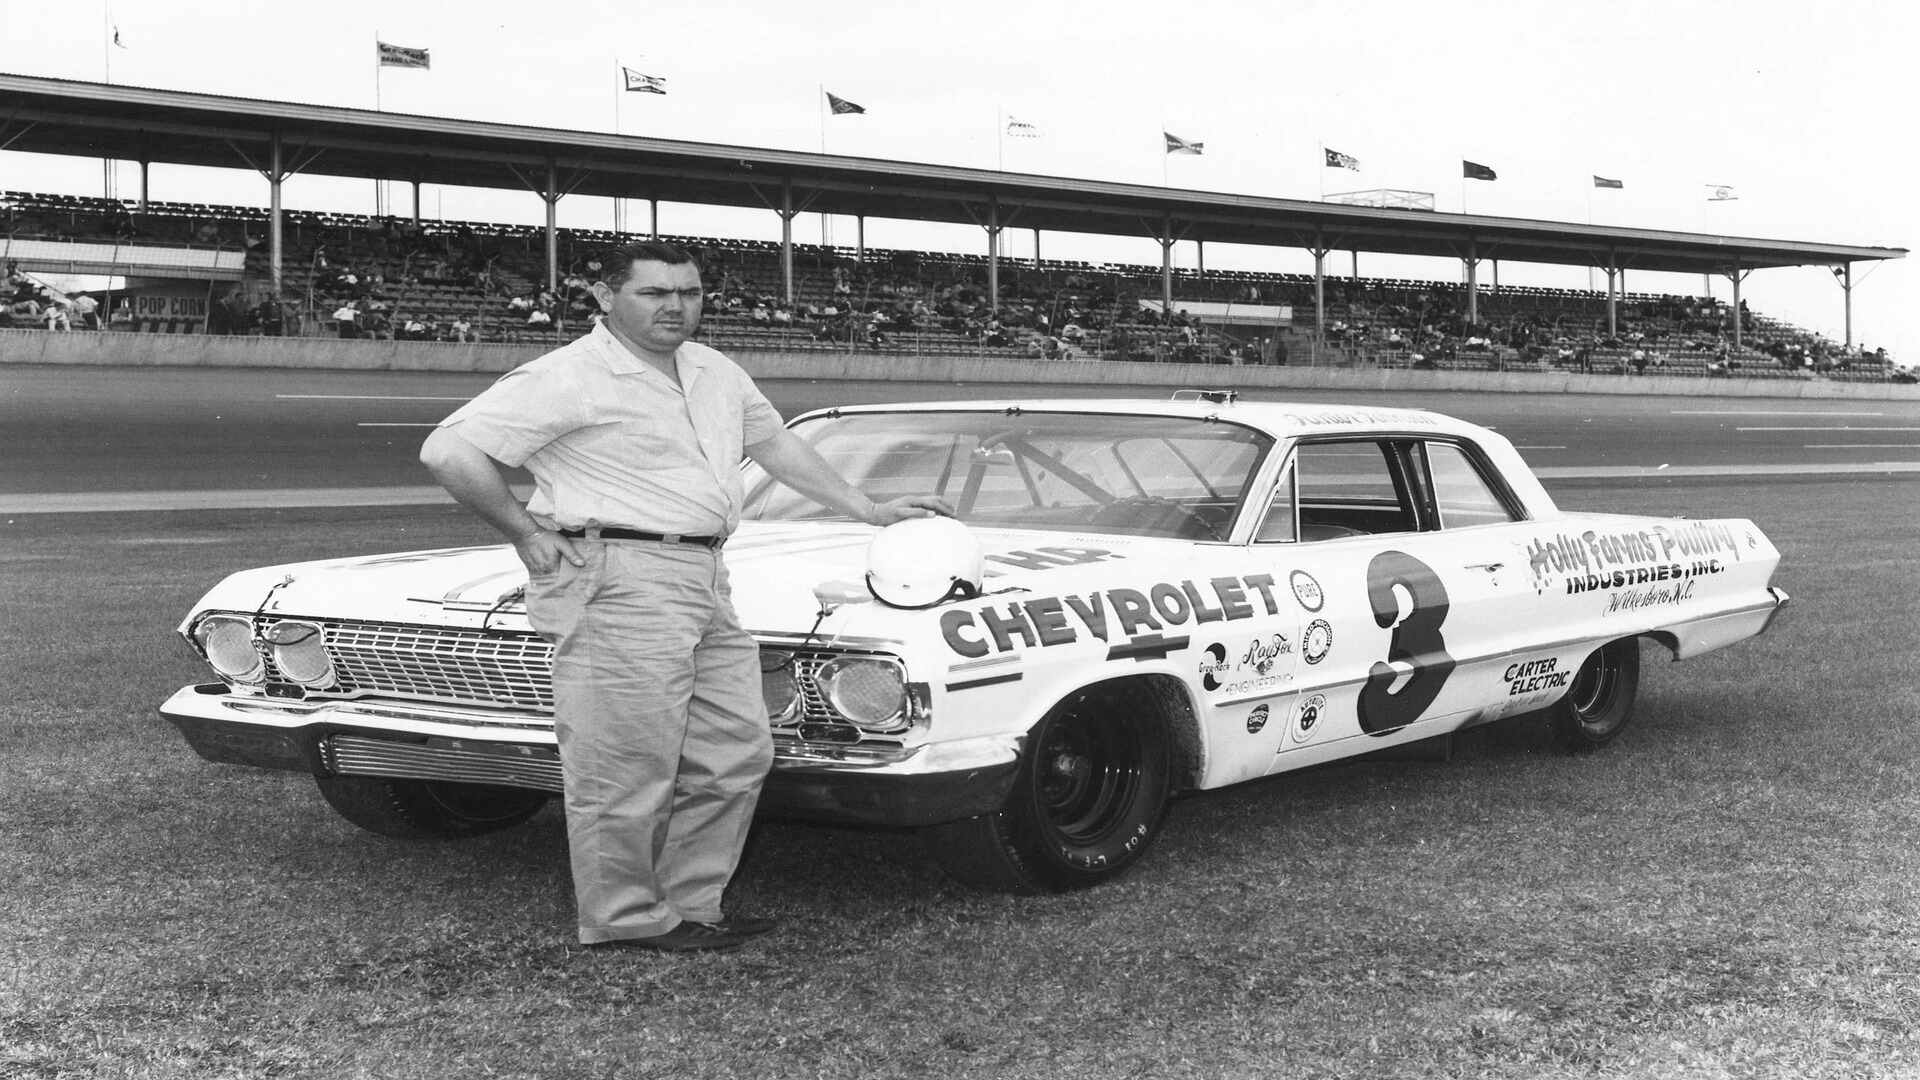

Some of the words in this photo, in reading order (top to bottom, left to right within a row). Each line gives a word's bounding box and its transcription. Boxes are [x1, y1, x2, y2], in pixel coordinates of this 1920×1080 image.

[139, 297, 166, 315] POP
[171, 297, 206, 317] CORN
[1527, 532, 1590, 584] Holly
[1581, 530, 1657, 570] Farms
[1649, 521, 1740, 562] Poultry
[1691, 558, 1725, 577] INC.
[1296, 583, 1319, 600] PURE
[940, 573, 1279, 658] CHEVROLET
[1242, 639, 1273, 666] Ray
[1271, 633, 1296, 657] Fox
[1357, 550, 1456, 737] 3
[1504, 657, 1558, 683] CARTER
[1509, 670, 1571, 696] ELECTRIC
